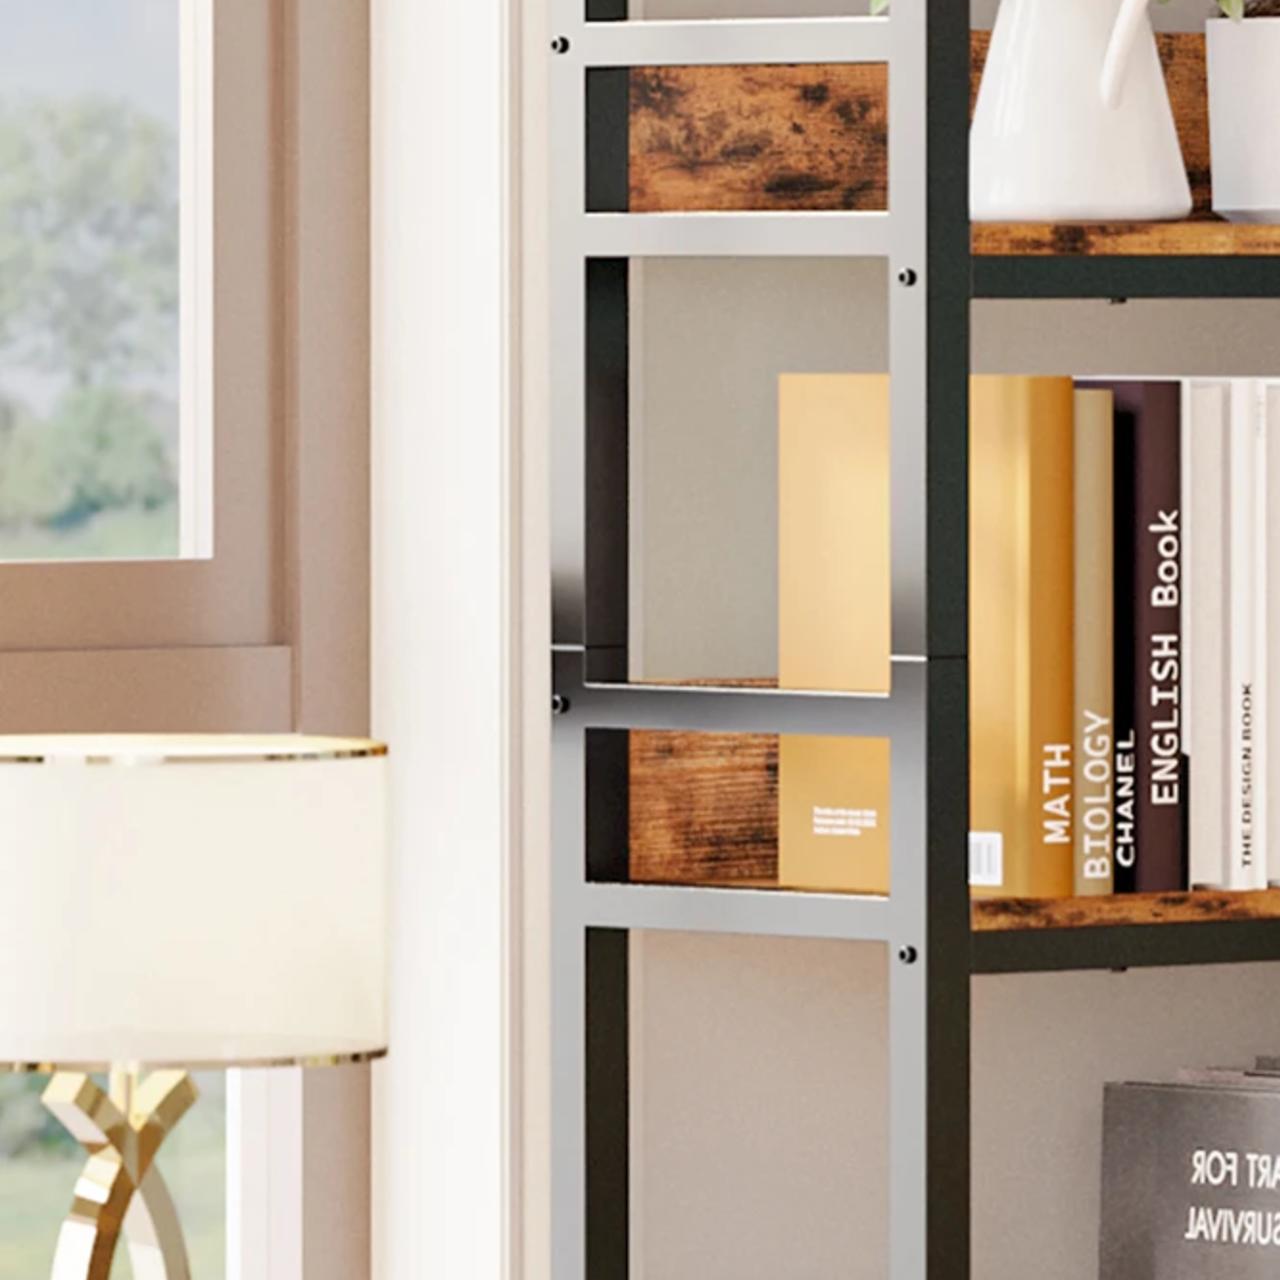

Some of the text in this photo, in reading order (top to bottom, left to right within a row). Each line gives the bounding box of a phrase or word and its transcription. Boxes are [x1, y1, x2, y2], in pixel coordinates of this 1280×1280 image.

[1148, 510, 1178, 804] ENGLISH Book
[1043, 744, 1071, 844] MATH
[1084, 710, 1110, 879] BIOLOGY
[1116, 729, 1135, 867] CHANEL
[1242, 683, 1252, 867] THE DESIGN BOOK
